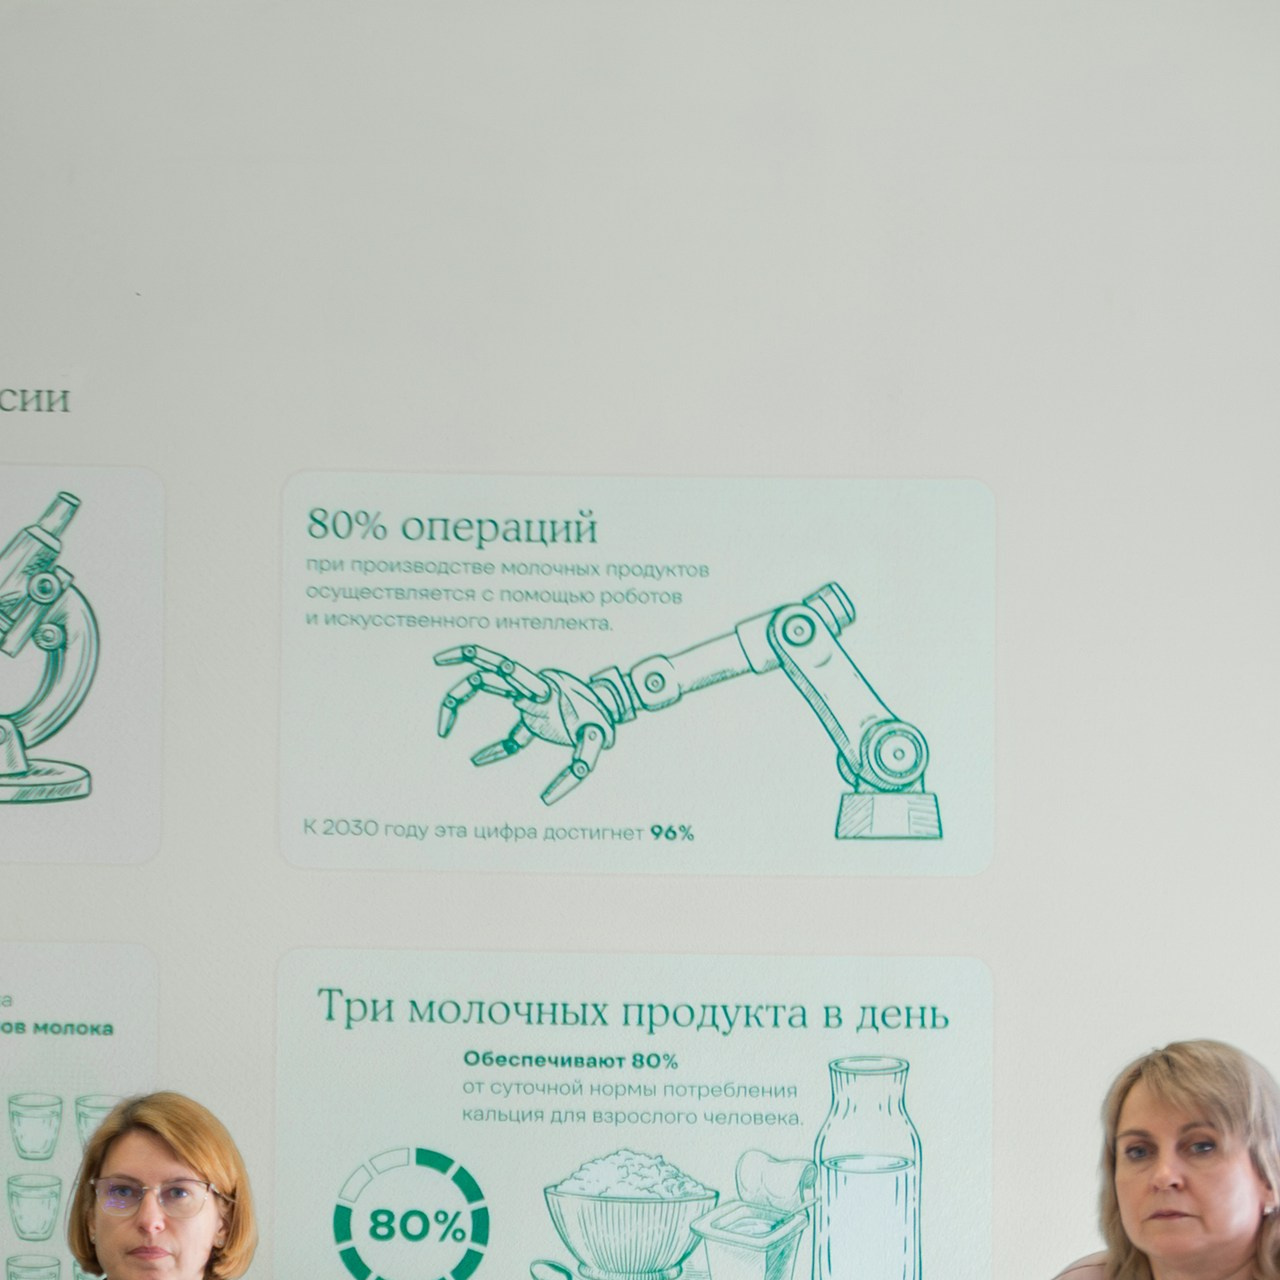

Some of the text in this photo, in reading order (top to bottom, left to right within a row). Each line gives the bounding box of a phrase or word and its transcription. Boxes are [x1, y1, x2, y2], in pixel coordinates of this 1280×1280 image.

[307, 508, 597, 550] 80% операций
[306, 558, 709, 581] при производстве молочных продуктов
[306, 586, 683, 607] осуществляется с помощью роботов
[305, 613, 612, 631] и искусственного интеллекта.
[303, 818, 694, 842] К 2030 году эта цифра достигнет 96%
[317, 987, 949, 1036] Три молочных продукта в день
[33, 1022, 114, 1036] молока
[464, 1050, 678, 1069] Обеспечивают 80%
[462, 1079, 797, 1101] от суточной нормы потребления
[462, 1109, 803, 1126] кальция для взрослого человека.
[369, 1209, 466, 1242] 80%
